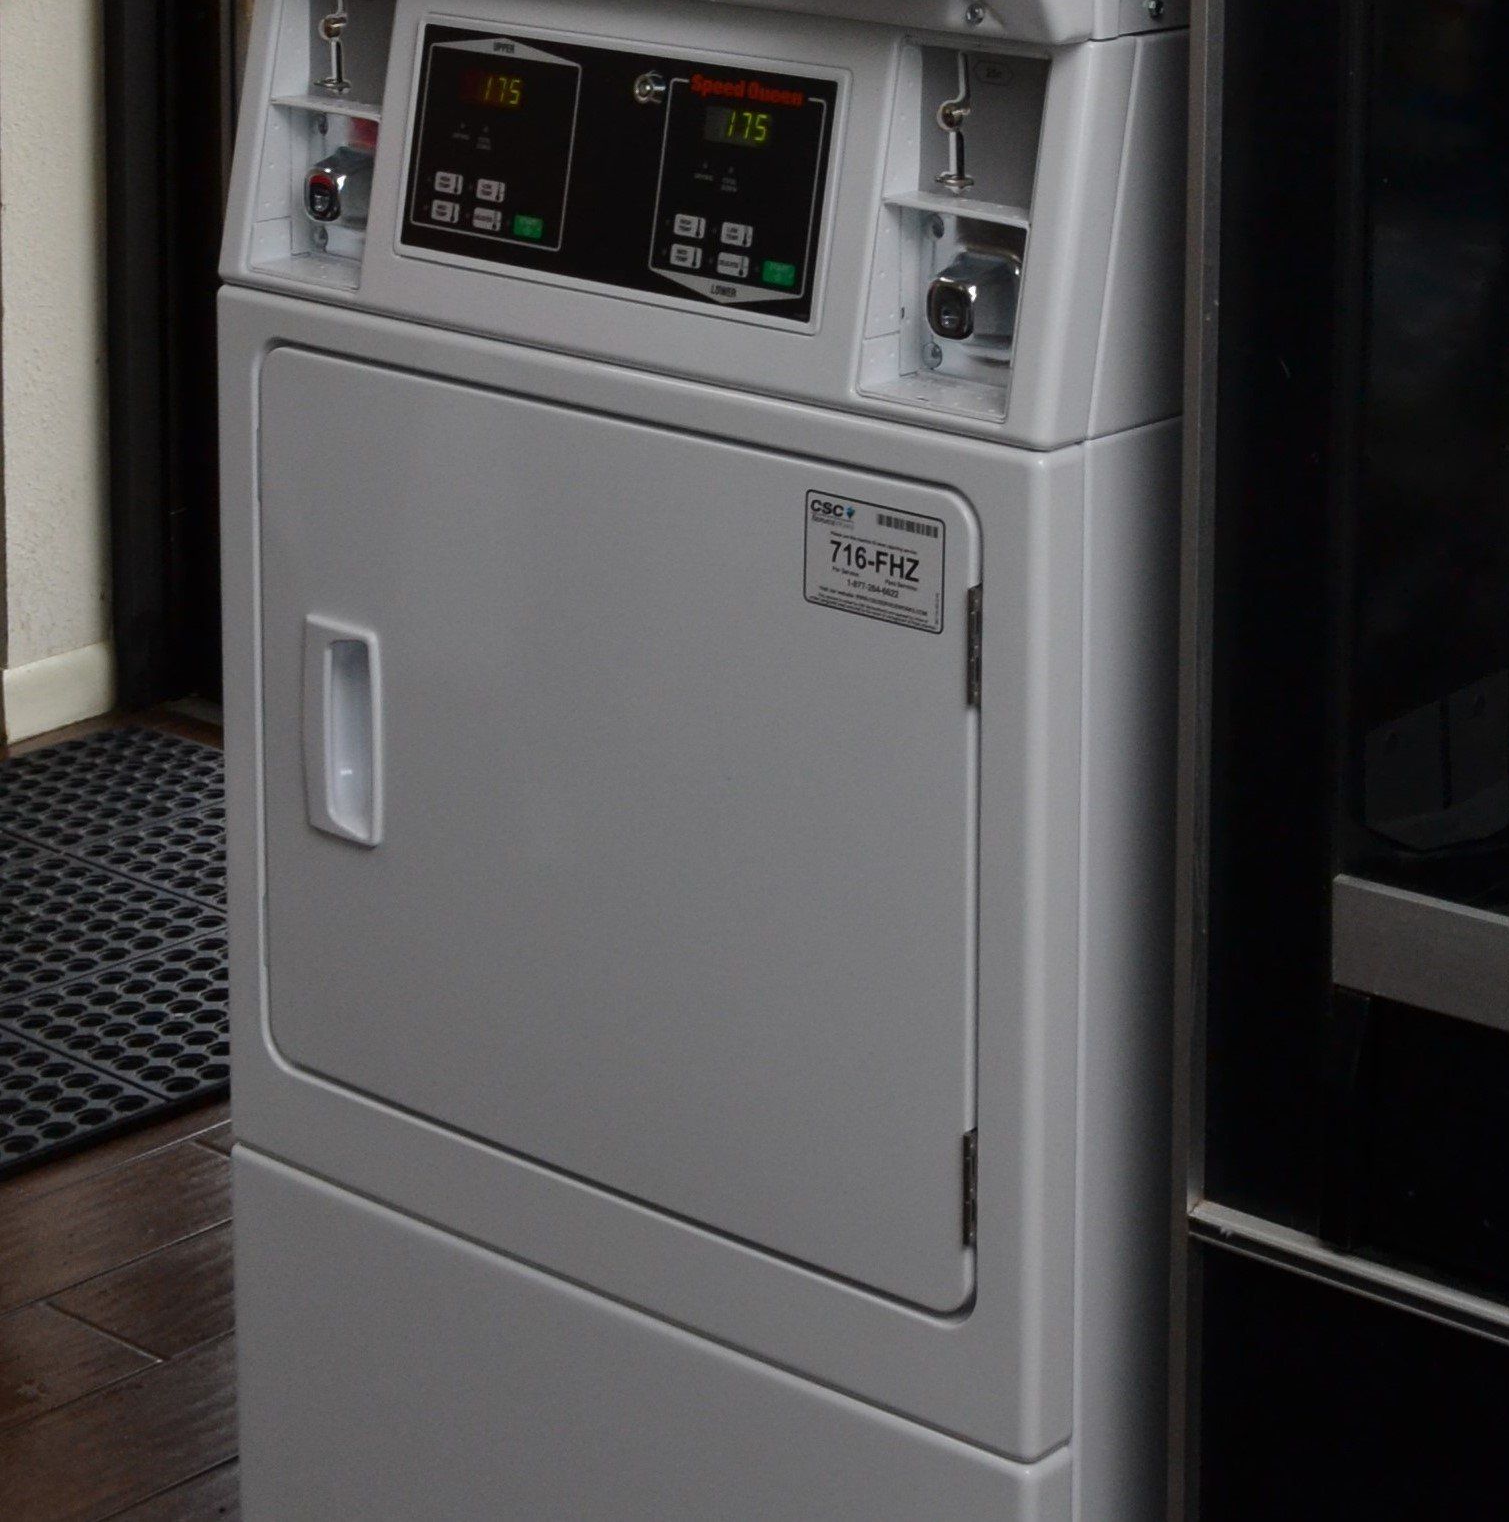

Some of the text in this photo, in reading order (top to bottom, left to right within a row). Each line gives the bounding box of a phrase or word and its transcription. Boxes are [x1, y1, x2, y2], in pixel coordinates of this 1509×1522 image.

[689, 72, 806, 110] Speed Queen
[726, 110, 770, 142] 175
[710, 284, 738, 298] LOWER
[810, 499, 845, 518] CSC
[830, 539, 920, 583] 716-FHZ
